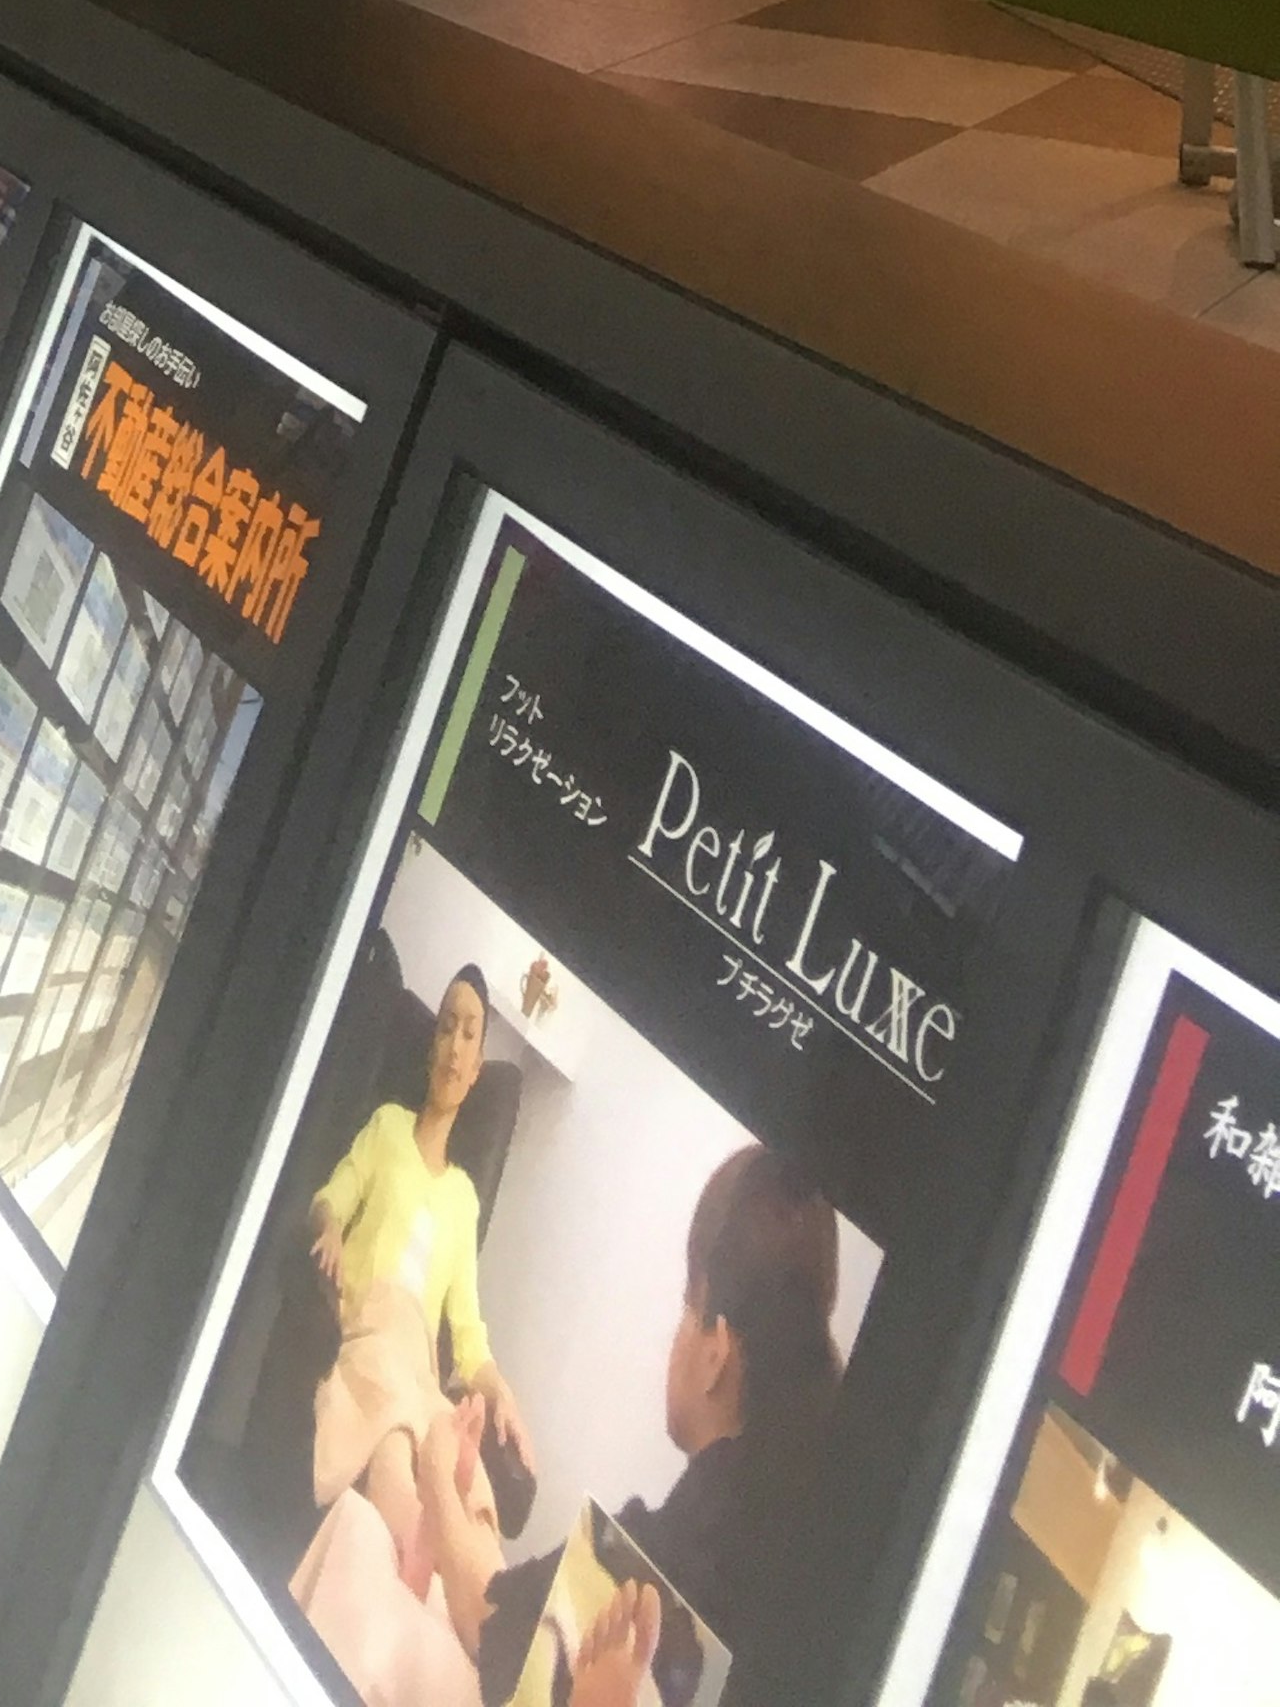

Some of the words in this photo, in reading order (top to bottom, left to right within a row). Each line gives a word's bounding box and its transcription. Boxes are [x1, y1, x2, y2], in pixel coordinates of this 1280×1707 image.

[99, 301, 201, 389] お部屋探しのお手伝い
[80, 362, 320, 644] 不動産総合案内所
[500, 675, 546, 725] フット
[488, 716, 608, 830] リラクゼーション
[637, 749, 781, 947] Petit
[786, 861, 960, 1085] Luxe
